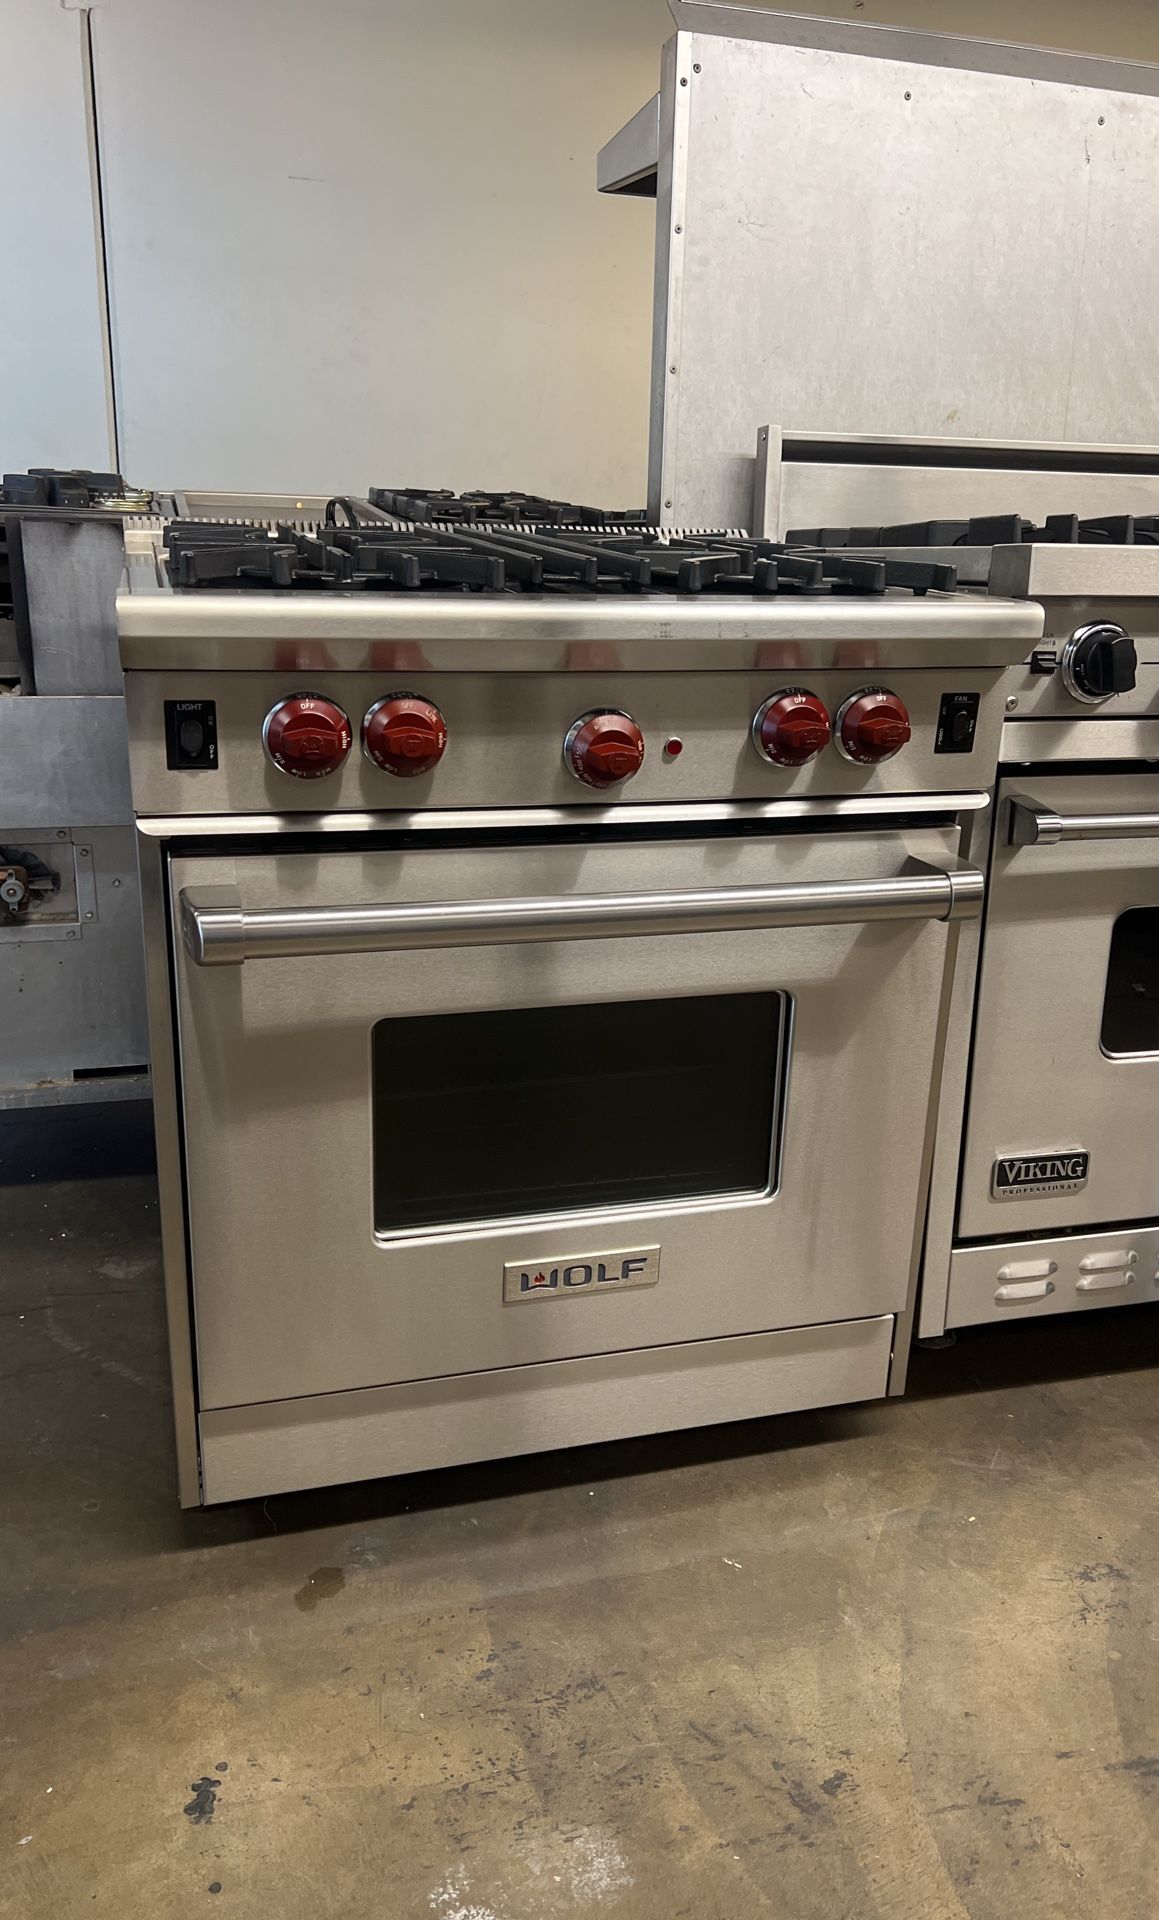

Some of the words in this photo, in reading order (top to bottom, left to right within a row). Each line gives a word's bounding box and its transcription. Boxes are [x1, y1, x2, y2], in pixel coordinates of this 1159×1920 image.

[176, 703, 203, 711] LIGHT
[425, 709, 438, 723] LITE
[1002, 1157, 1084, 1184] VIKING
[1002, 1183, 1079, 1196] PROFESSIONAL
[520, 1257, 648, 1293] WOLF
